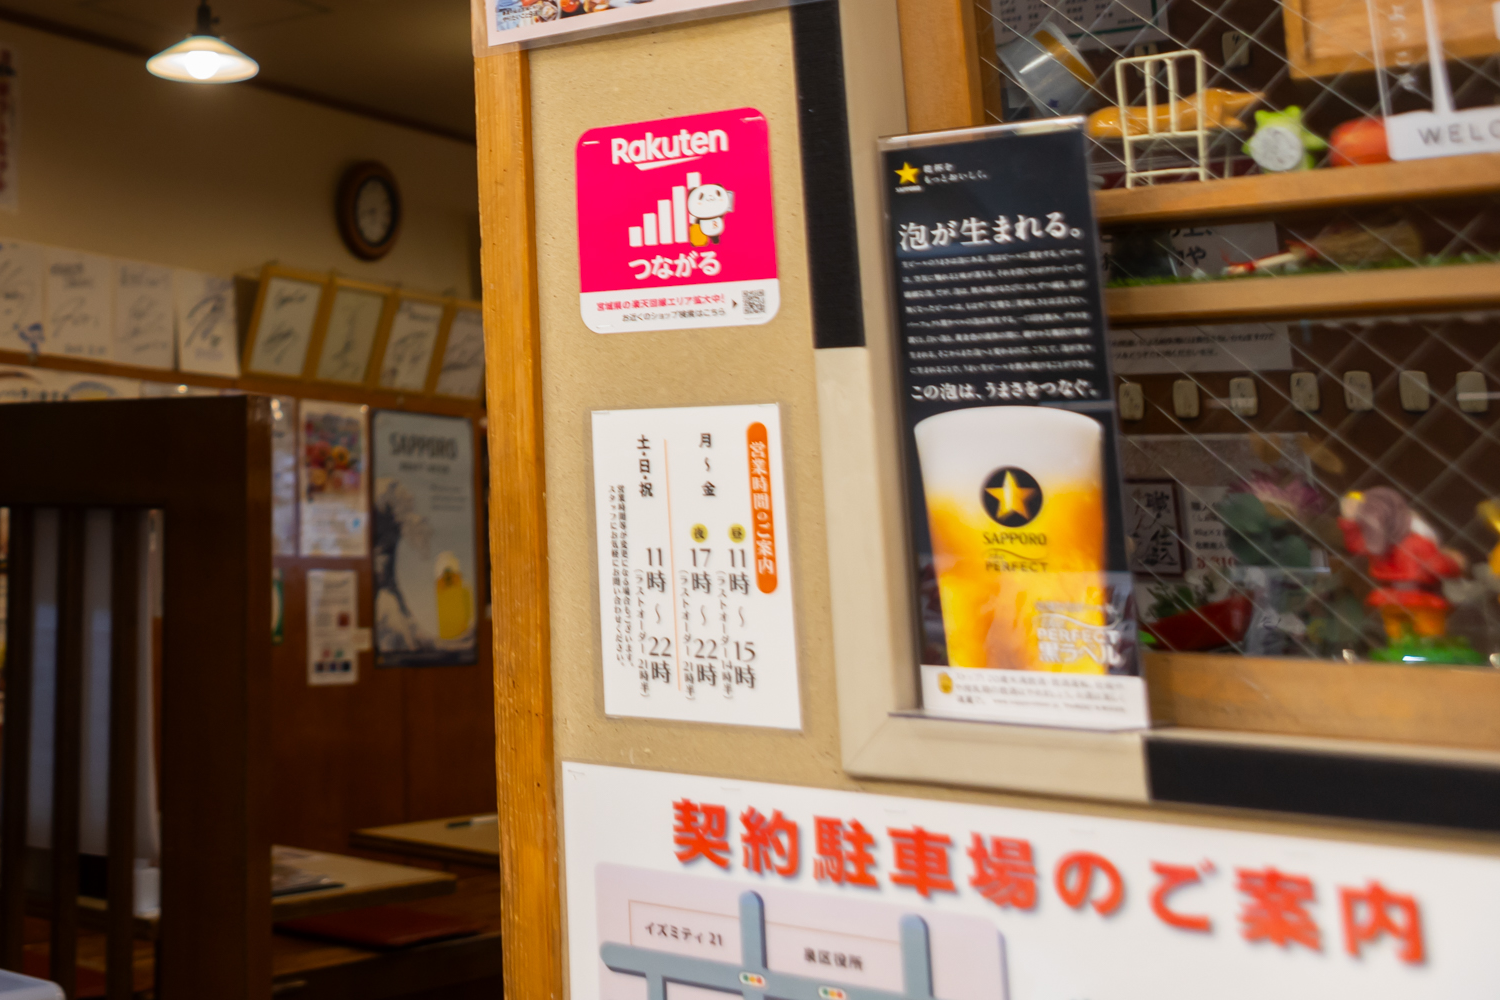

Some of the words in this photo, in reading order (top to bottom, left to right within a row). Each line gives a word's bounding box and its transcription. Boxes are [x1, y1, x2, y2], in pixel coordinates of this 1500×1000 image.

[611, 128, 730, 165] Rakuten
[899, 211, 1085, 251] 泡が生まれる。
[628, 250, 722, 280] つながる
[911, 379, 1098, 402] この泡は、うまさをつなぐ。
[636, 434, 654, 498] 土・日・祝
[750, 440, 775, 575] 営業時間のご案内
[982, 531, 1047, 546] SAPPORO
[985, 560, 1049, 573] PERFECT
[1037, 627, 1122, 646] PERFECT
[672, 798, 1432, 968] 契約駐車場のご案内
[708, 932, 724, 947] 21
